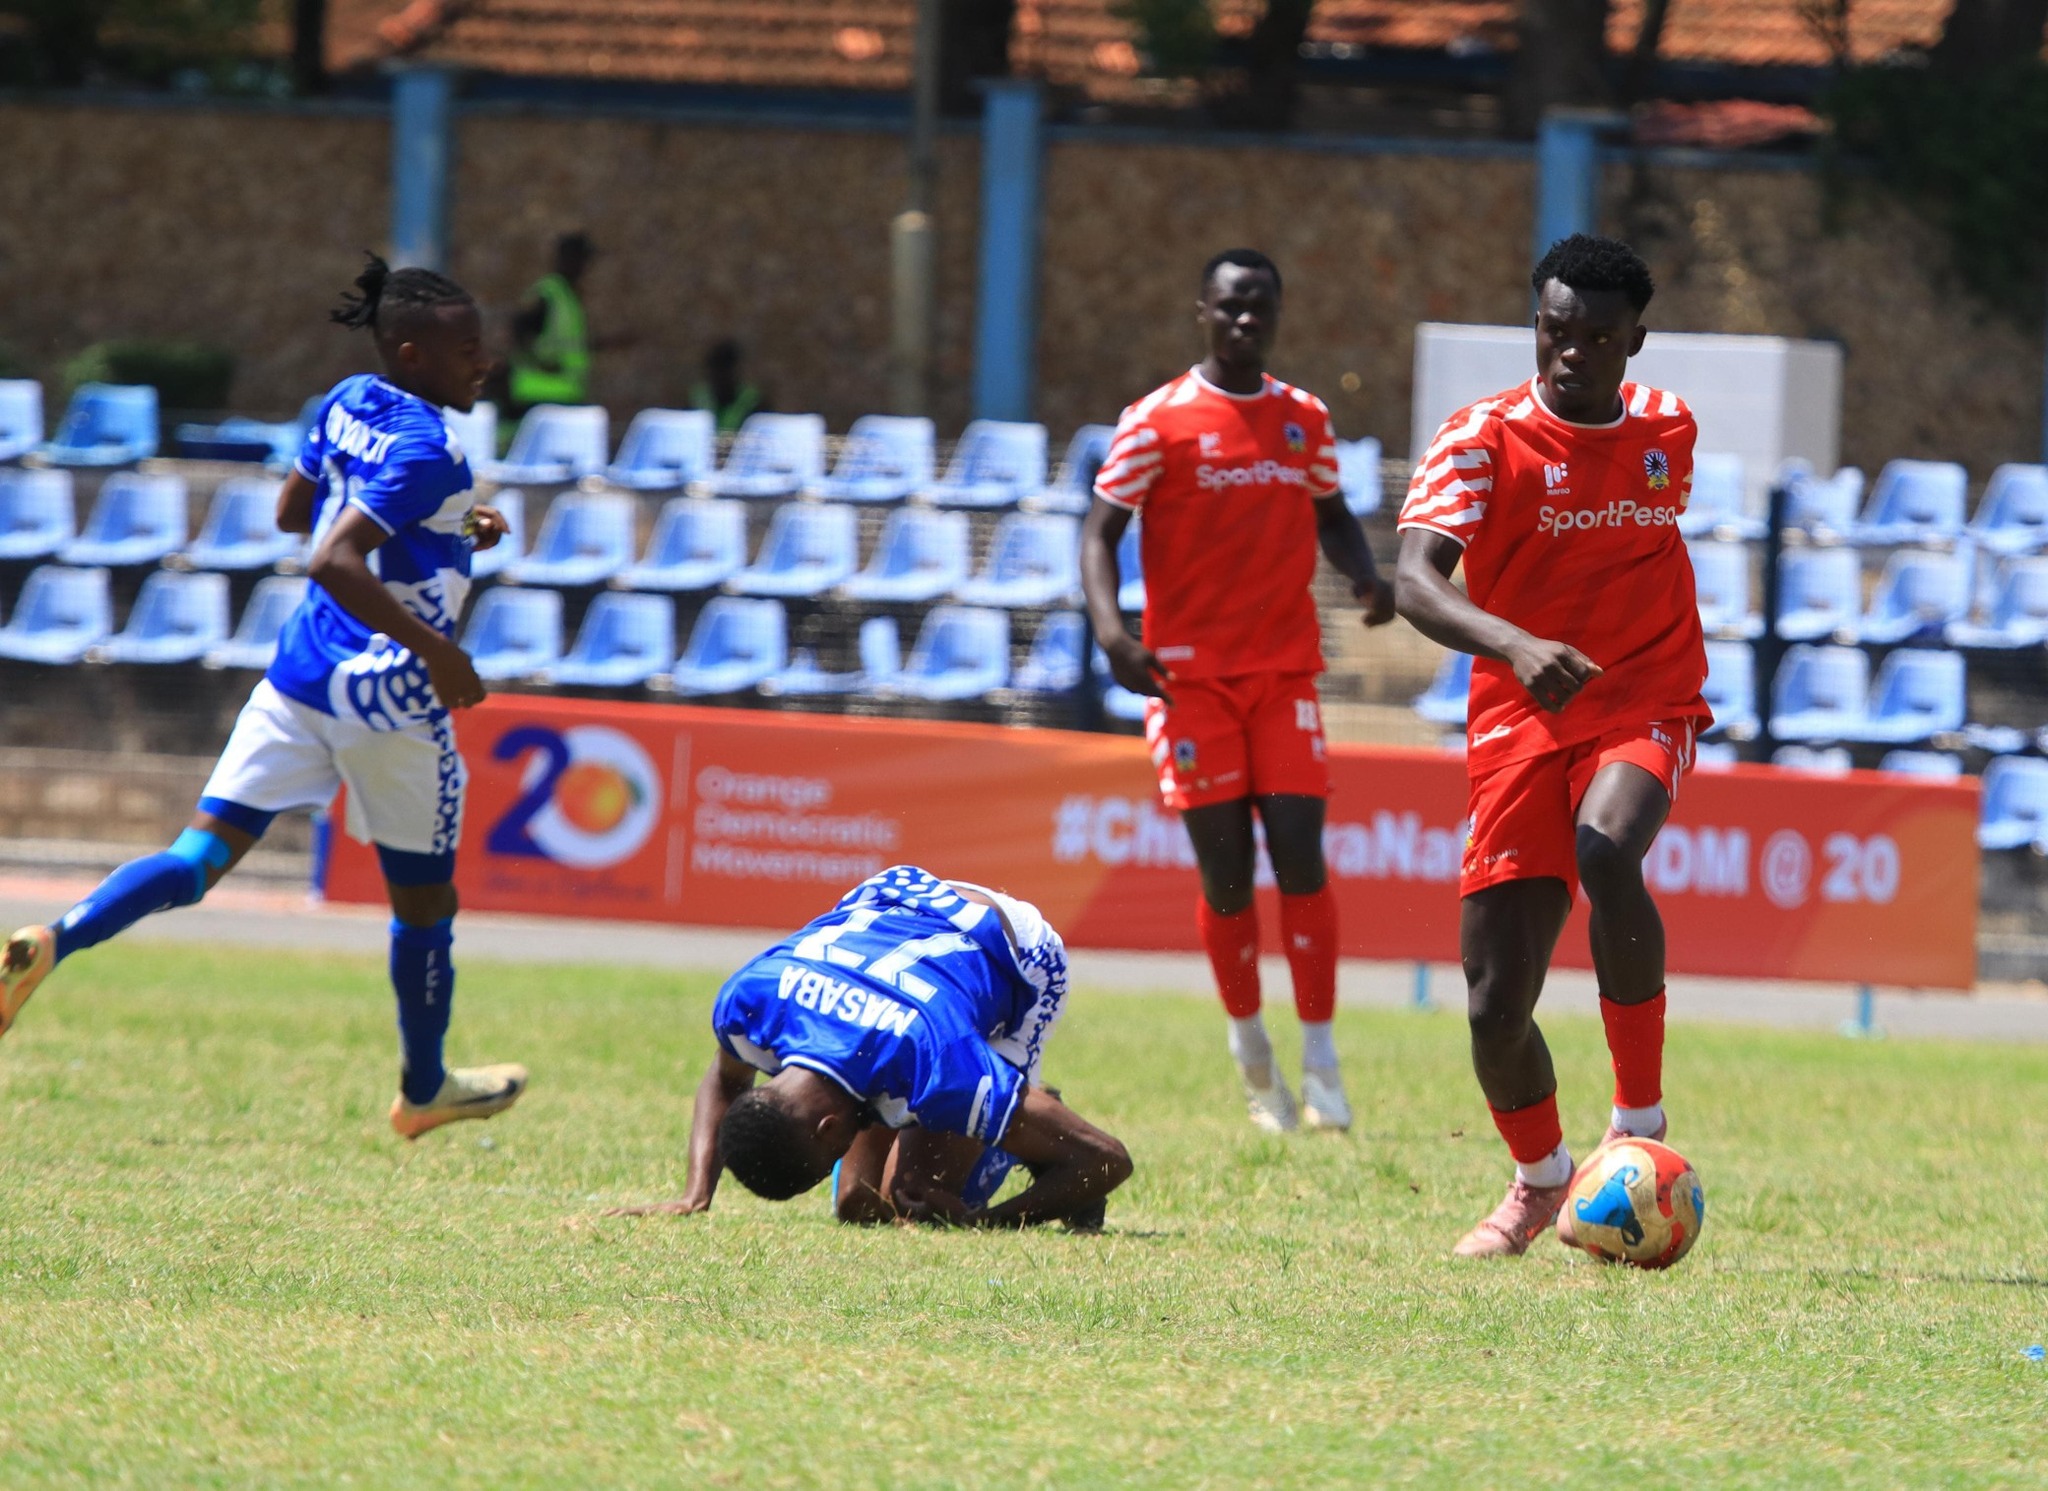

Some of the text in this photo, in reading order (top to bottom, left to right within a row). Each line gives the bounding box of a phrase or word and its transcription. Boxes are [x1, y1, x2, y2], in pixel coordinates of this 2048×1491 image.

[1536, 499, 1676, 538] SportPesa
[486, 722, 665, 871] 20
[696, 766, 832, 812] Orange
[694, 801, 900, 852] Democratic
[692, 842, 886, 883] Movement
[1642, 823, 1750, 897] DM
[1821, 831, 1900, 905] 20
[778, 966, 919, 1037] MASABA
